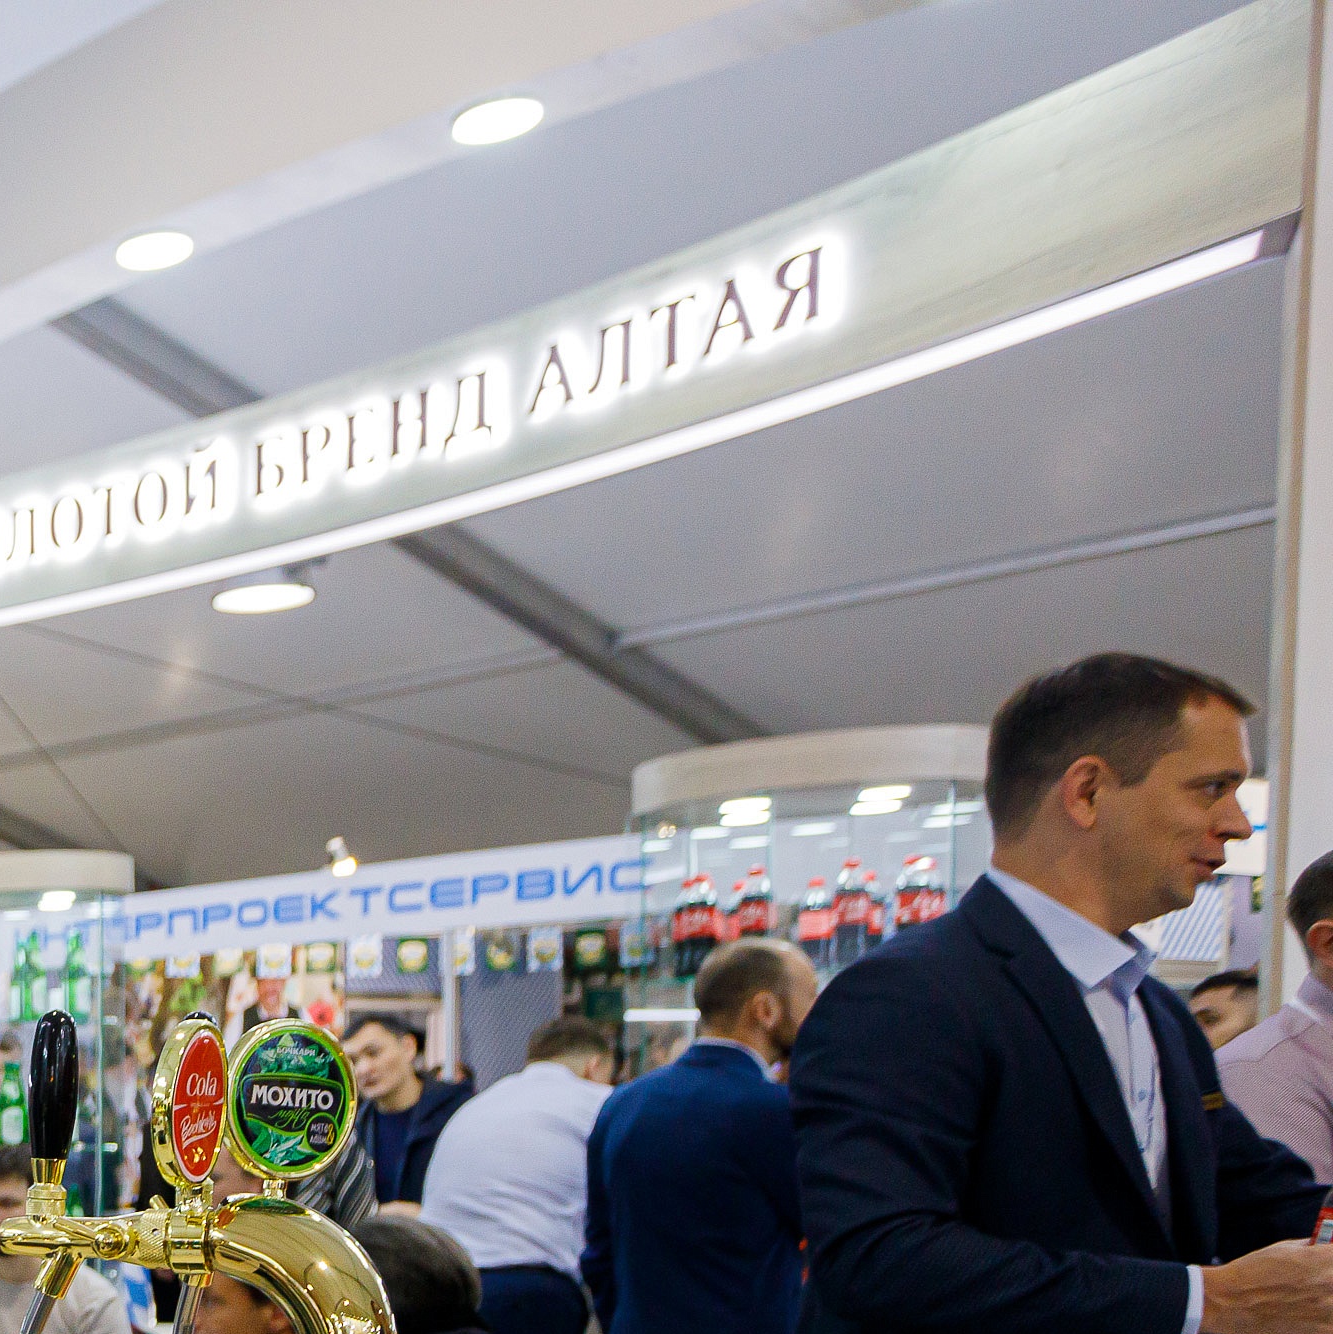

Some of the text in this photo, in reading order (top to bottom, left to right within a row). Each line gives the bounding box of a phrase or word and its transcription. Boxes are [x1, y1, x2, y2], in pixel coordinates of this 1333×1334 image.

[252, 370, 495, 500] БРЕНД
[528, 245, 824, 415] АЛТАЯ
[186, 1072, 218, 1098] Cola
[250, 1084, 334, 1111] МОХИТО
